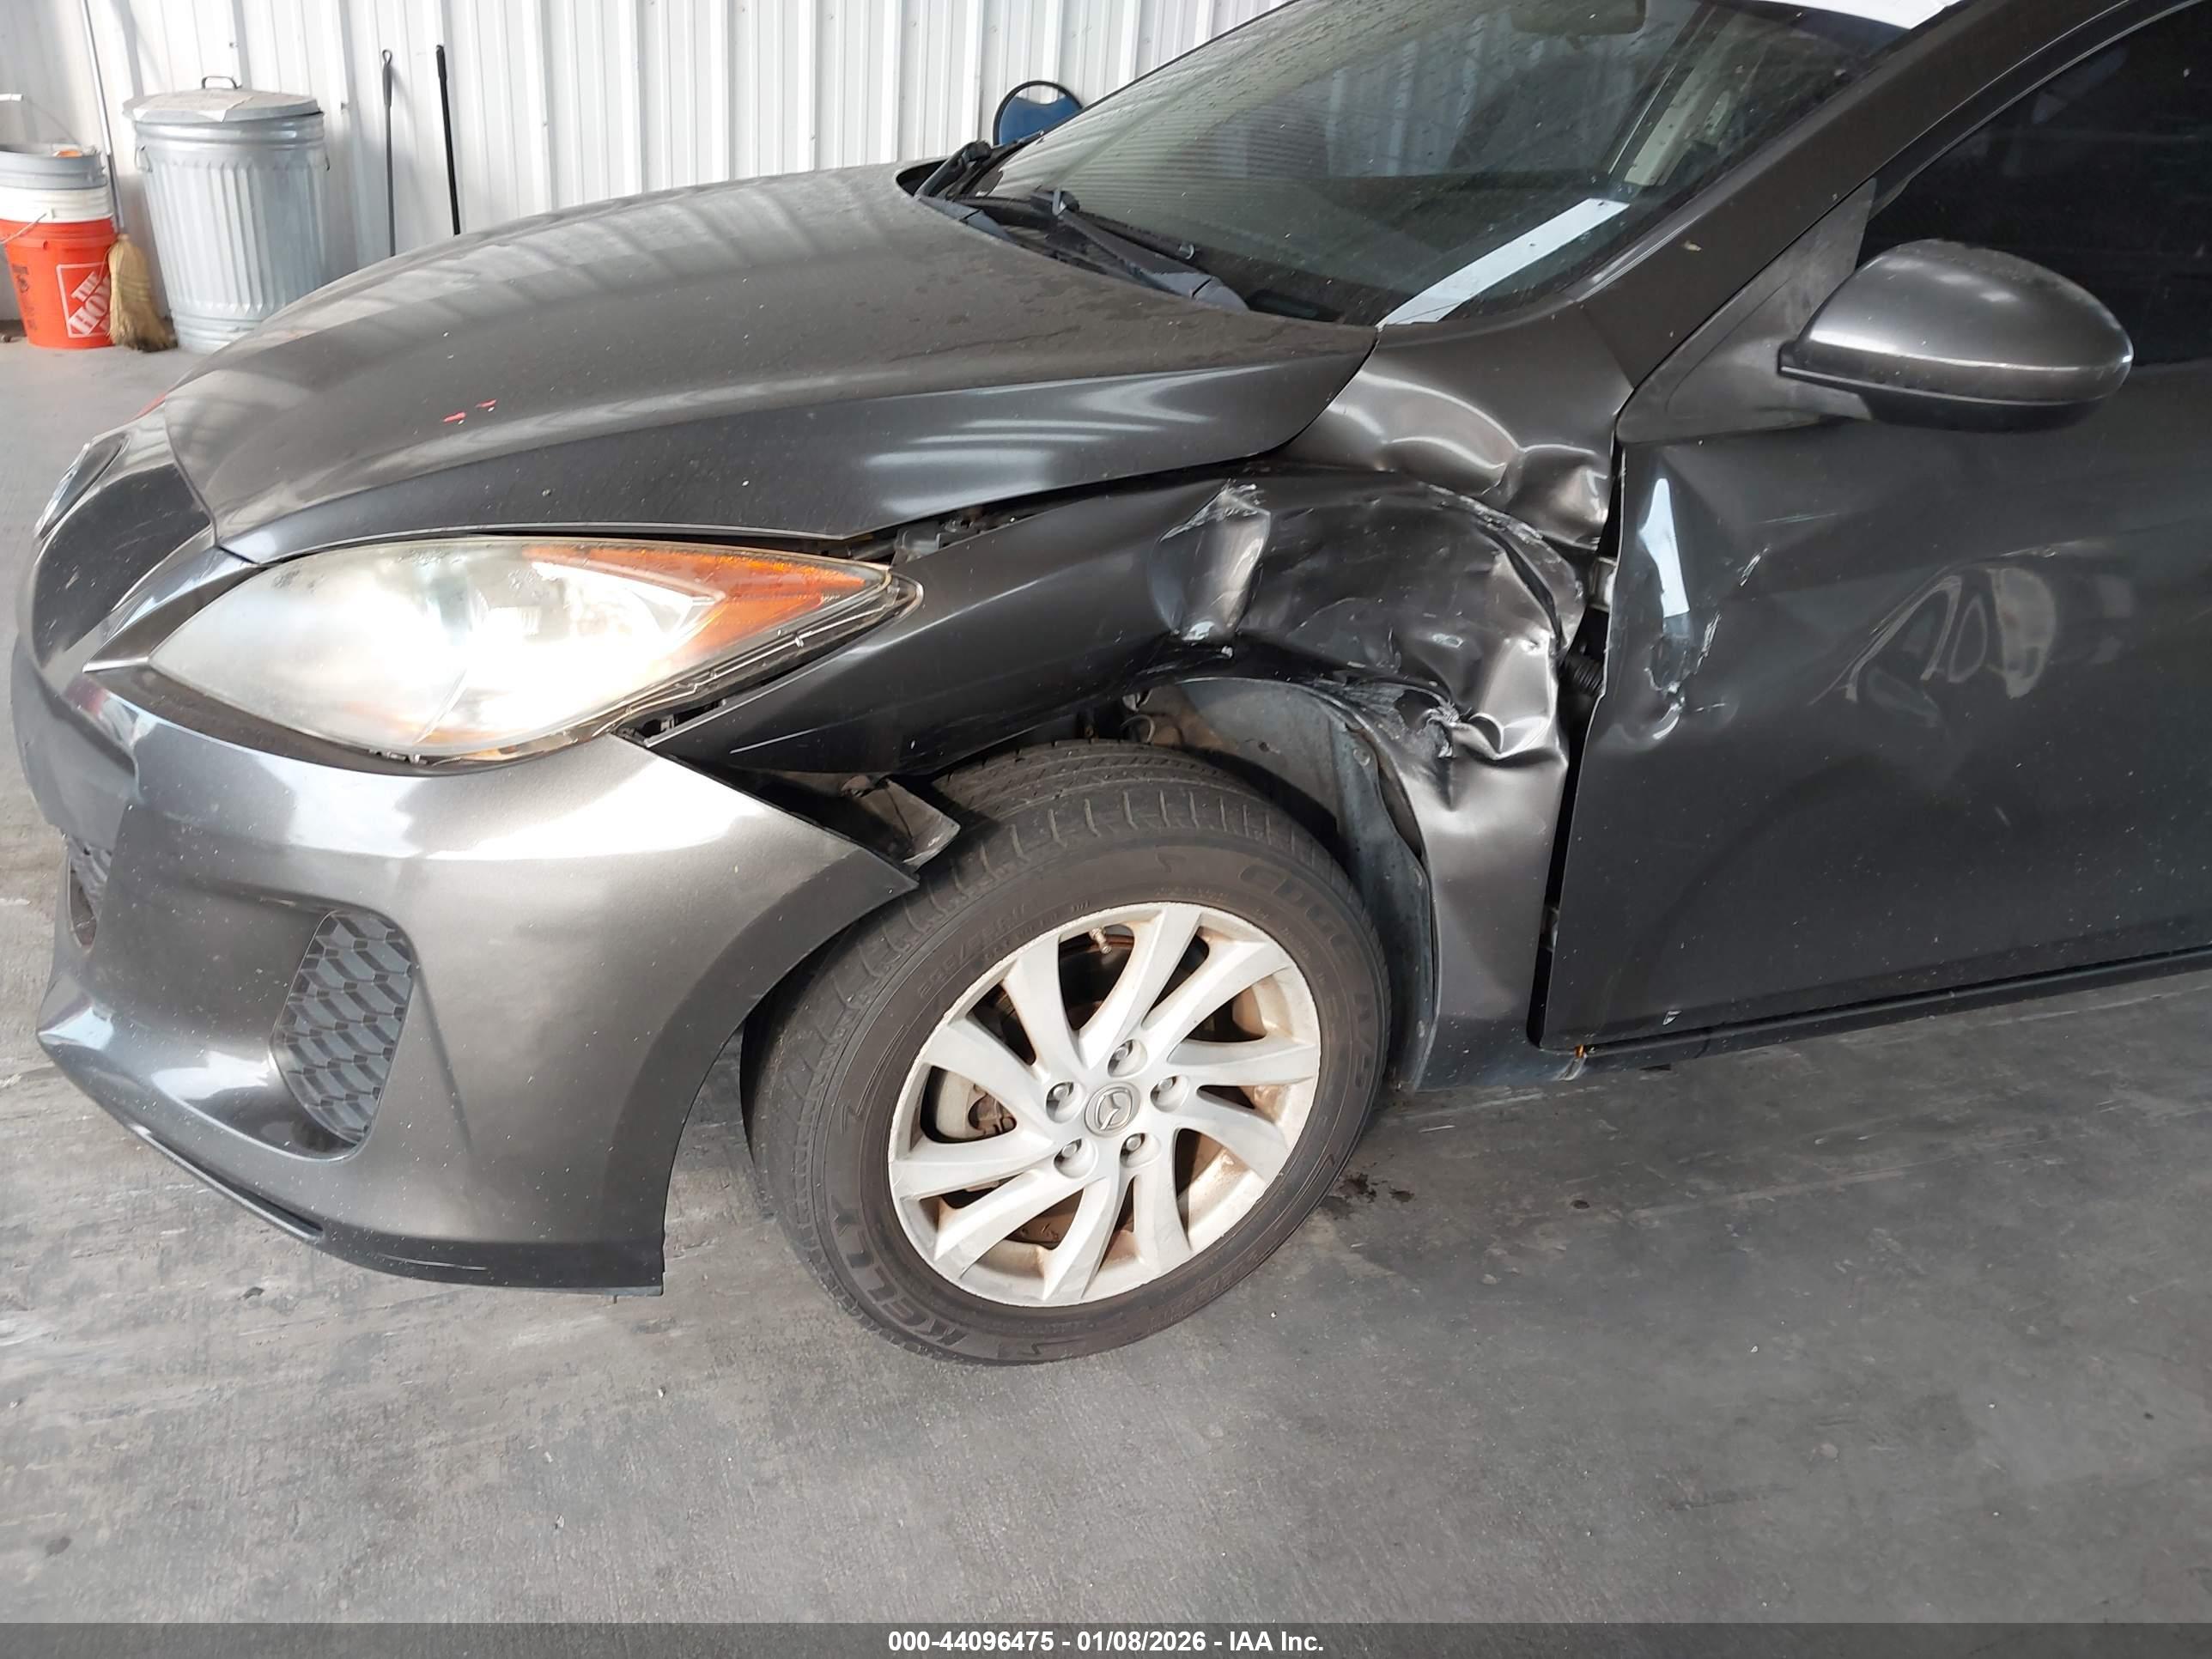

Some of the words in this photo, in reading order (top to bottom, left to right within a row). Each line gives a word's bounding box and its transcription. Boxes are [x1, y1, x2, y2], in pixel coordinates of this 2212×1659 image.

[68, 275, 110, 335] HO
[70, 270, 98, 303] THE
[830, 1194, 969, 1348] KELLY
